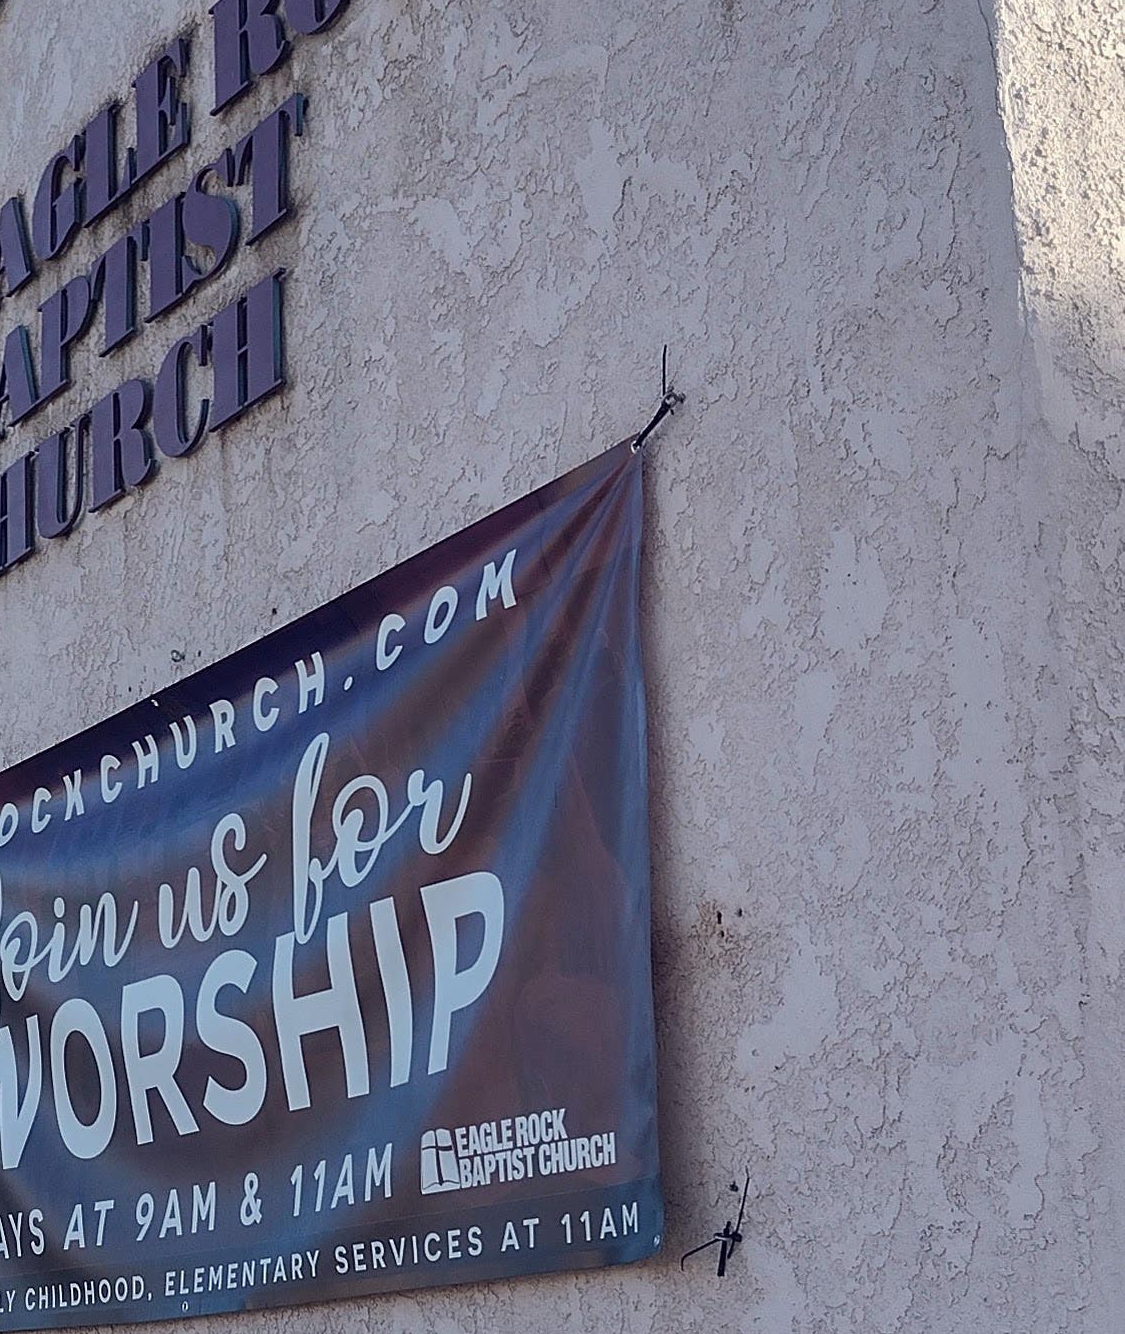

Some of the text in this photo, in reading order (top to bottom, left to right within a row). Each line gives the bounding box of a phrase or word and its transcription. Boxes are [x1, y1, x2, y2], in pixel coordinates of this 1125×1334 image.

[157, 812, 268, 950] us
[291, 731, 473, 945] for
[455, 1108, 568, 1158] EAGLE ROCK
[459, 1131, 617, 1190] BAPTIST CHURCH
[62, 1199, 115, 1251] AT
[135, 1181, 217, 1242] 9AM
[239, 1172, 263, 1227] &
[290, 1142, 393, 1217] 11AM
[24, 1275, 153, 1311] CHILDHOOD,
[164, 1249, 320, 1297] ELEMENTARY
[335, 1226, 483, 1274] SERVICES
[500, 1218, 540, 1252] AT
[560, 1201, 640, 1245] 11AM
